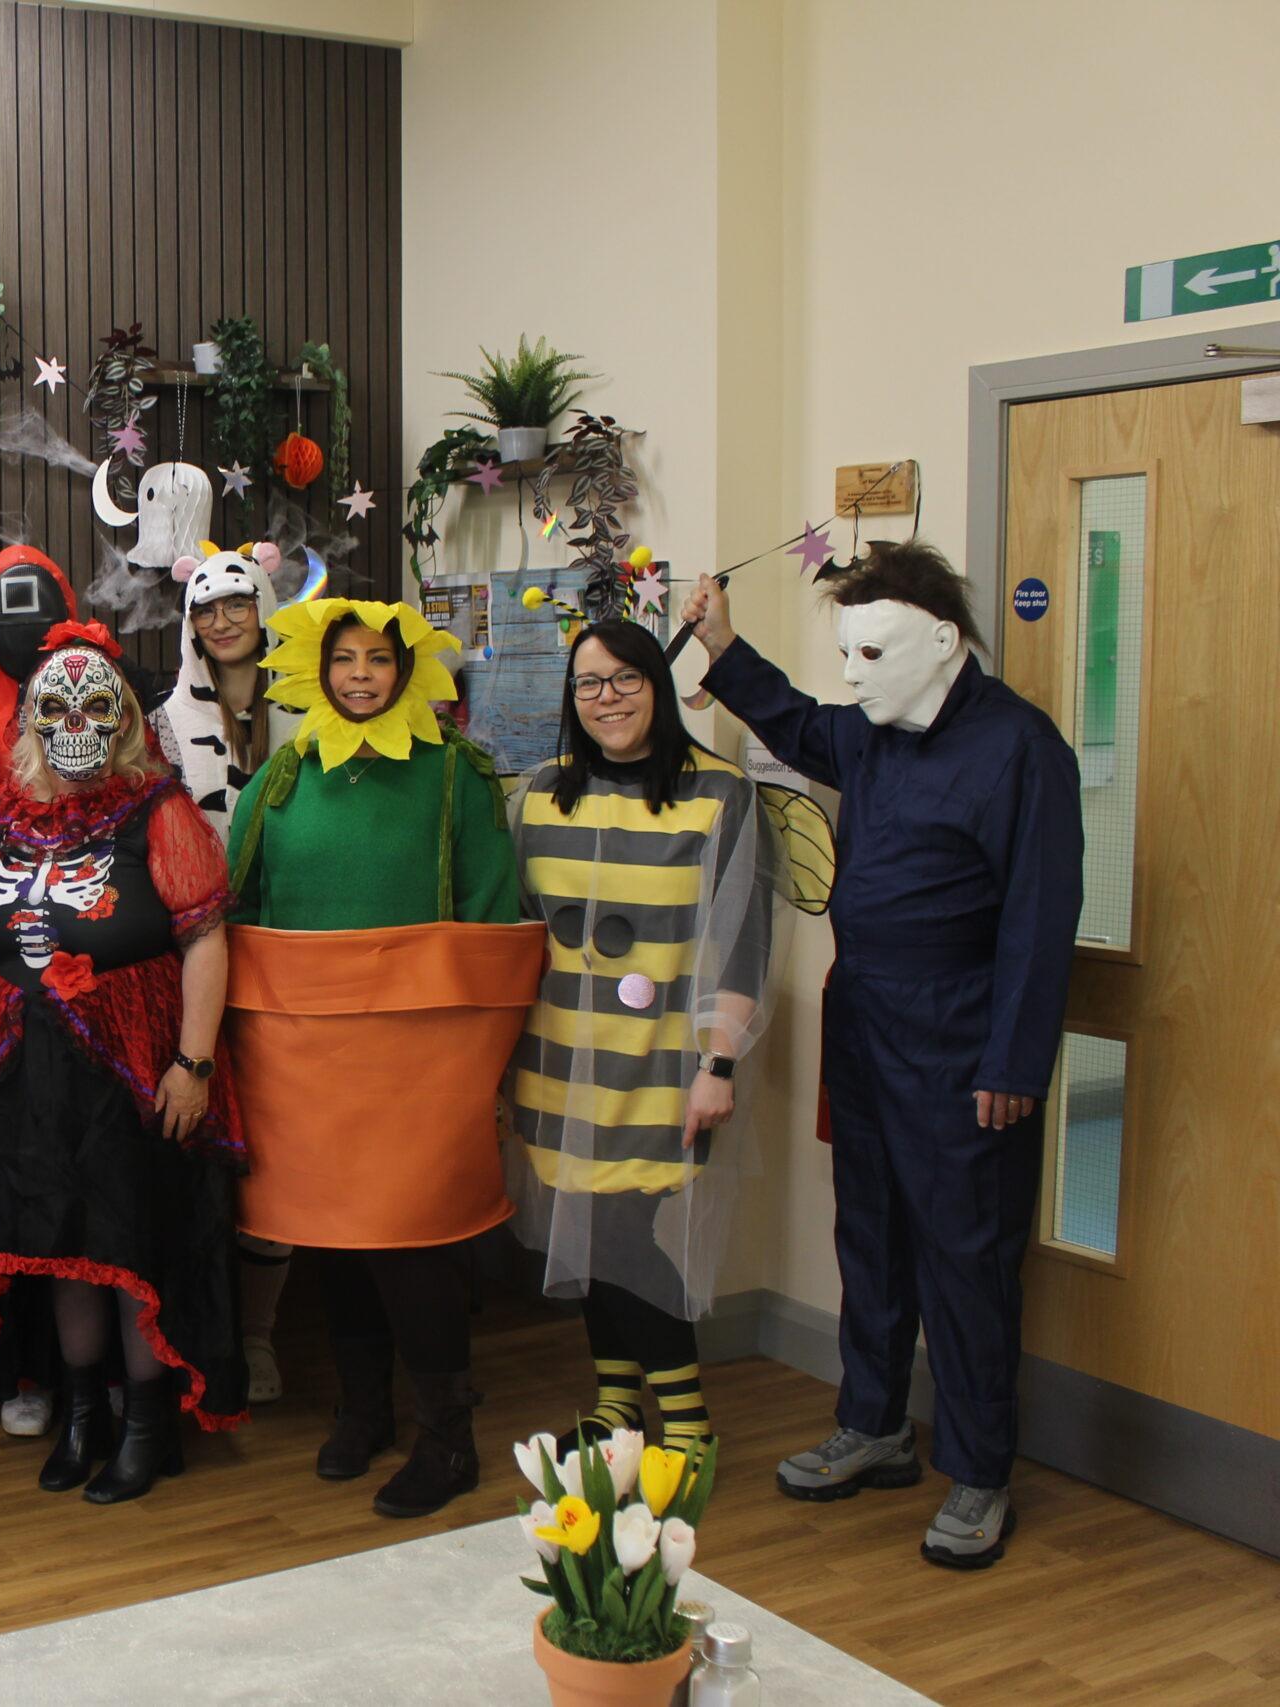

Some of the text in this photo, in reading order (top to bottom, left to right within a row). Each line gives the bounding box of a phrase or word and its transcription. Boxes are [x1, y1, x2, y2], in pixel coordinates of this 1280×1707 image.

[1016, 590, 1046, 598] Fire door
[1014, 599, 1047, 608] Keep shut
[747, 759, 786, 774] Suggestion
